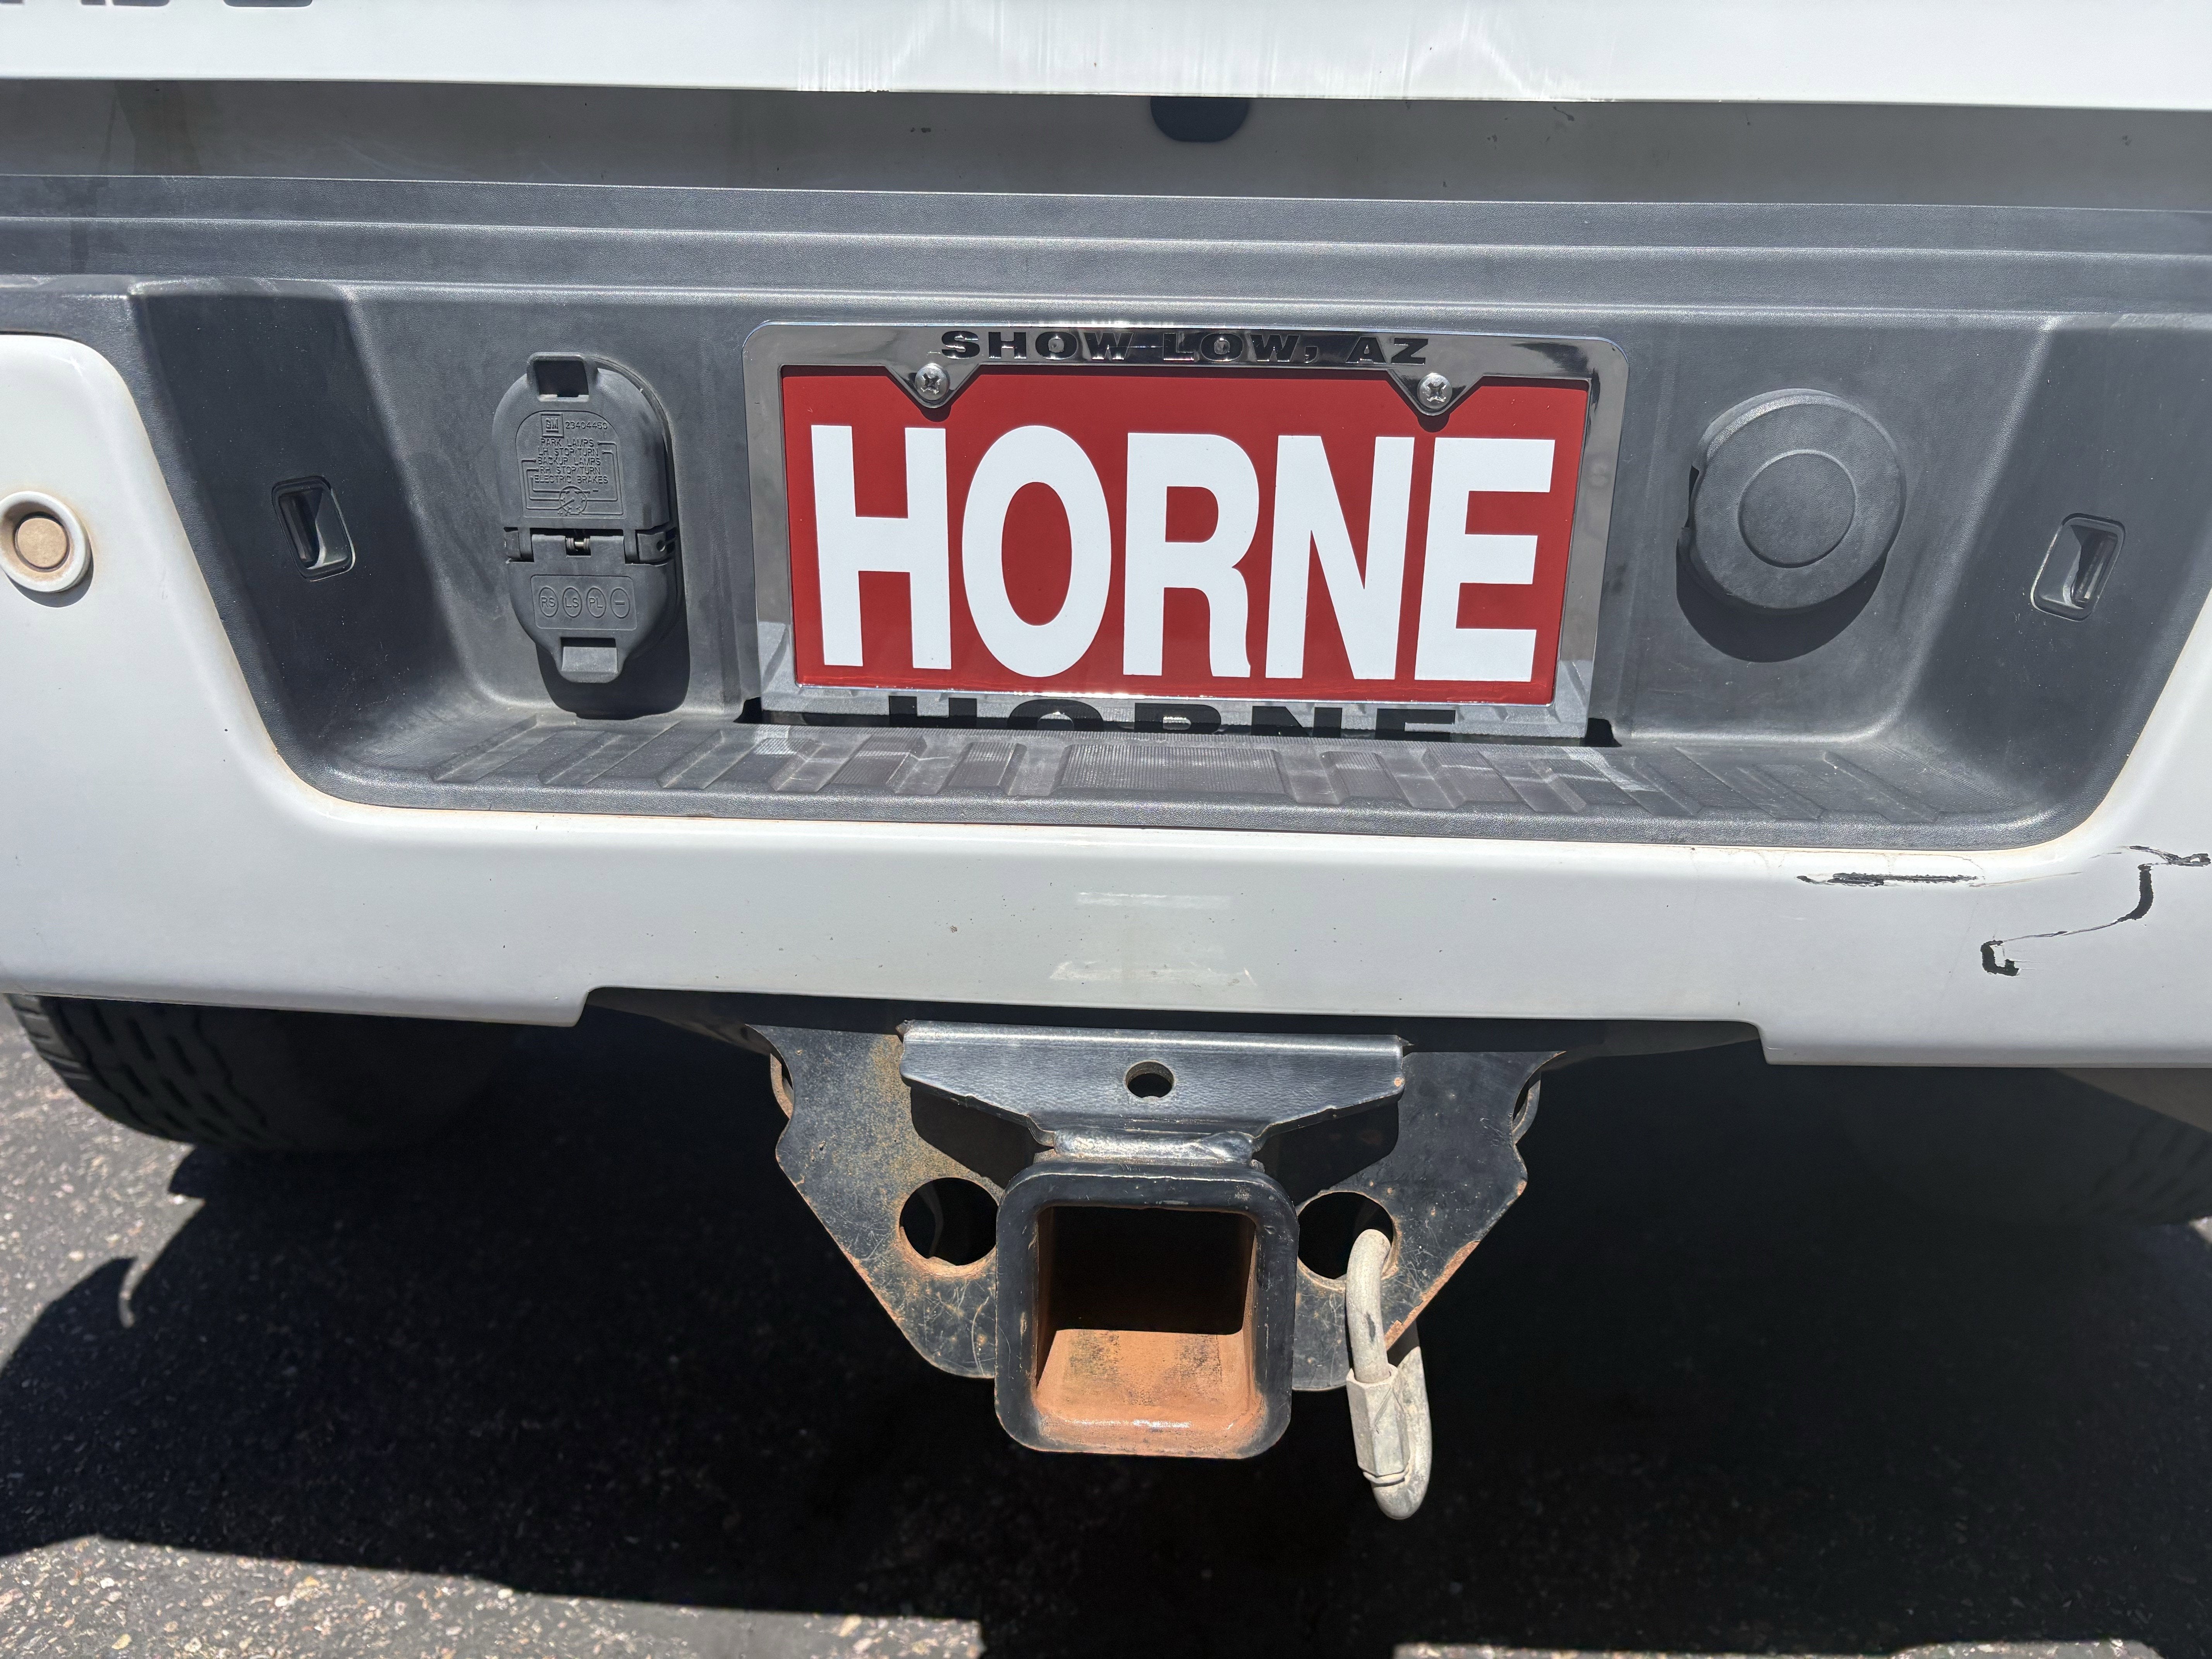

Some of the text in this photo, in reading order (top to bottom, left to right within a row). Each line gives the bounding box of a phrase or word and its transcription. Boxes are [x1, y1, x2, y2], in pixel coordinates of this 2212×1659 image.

[941, 331, 1429, 365] SHOW LOW, AZ
[541, 438, 594, 447] PARK LAMPS
[538, 446, 599, 457] LH STOP/TURN
[538, 456, 601, 466] BACKUP LAMPS
[540, 465, 601, 474] RH STOP/TURN
[534, 474, 609, 484] ELECTRIC BRAKES
[811, 424, 1555, 683] HORNE
[541, 596, 555, 607] RS
[565, 597, 579, 608] LS
[589, 597, 603, 608] PL
